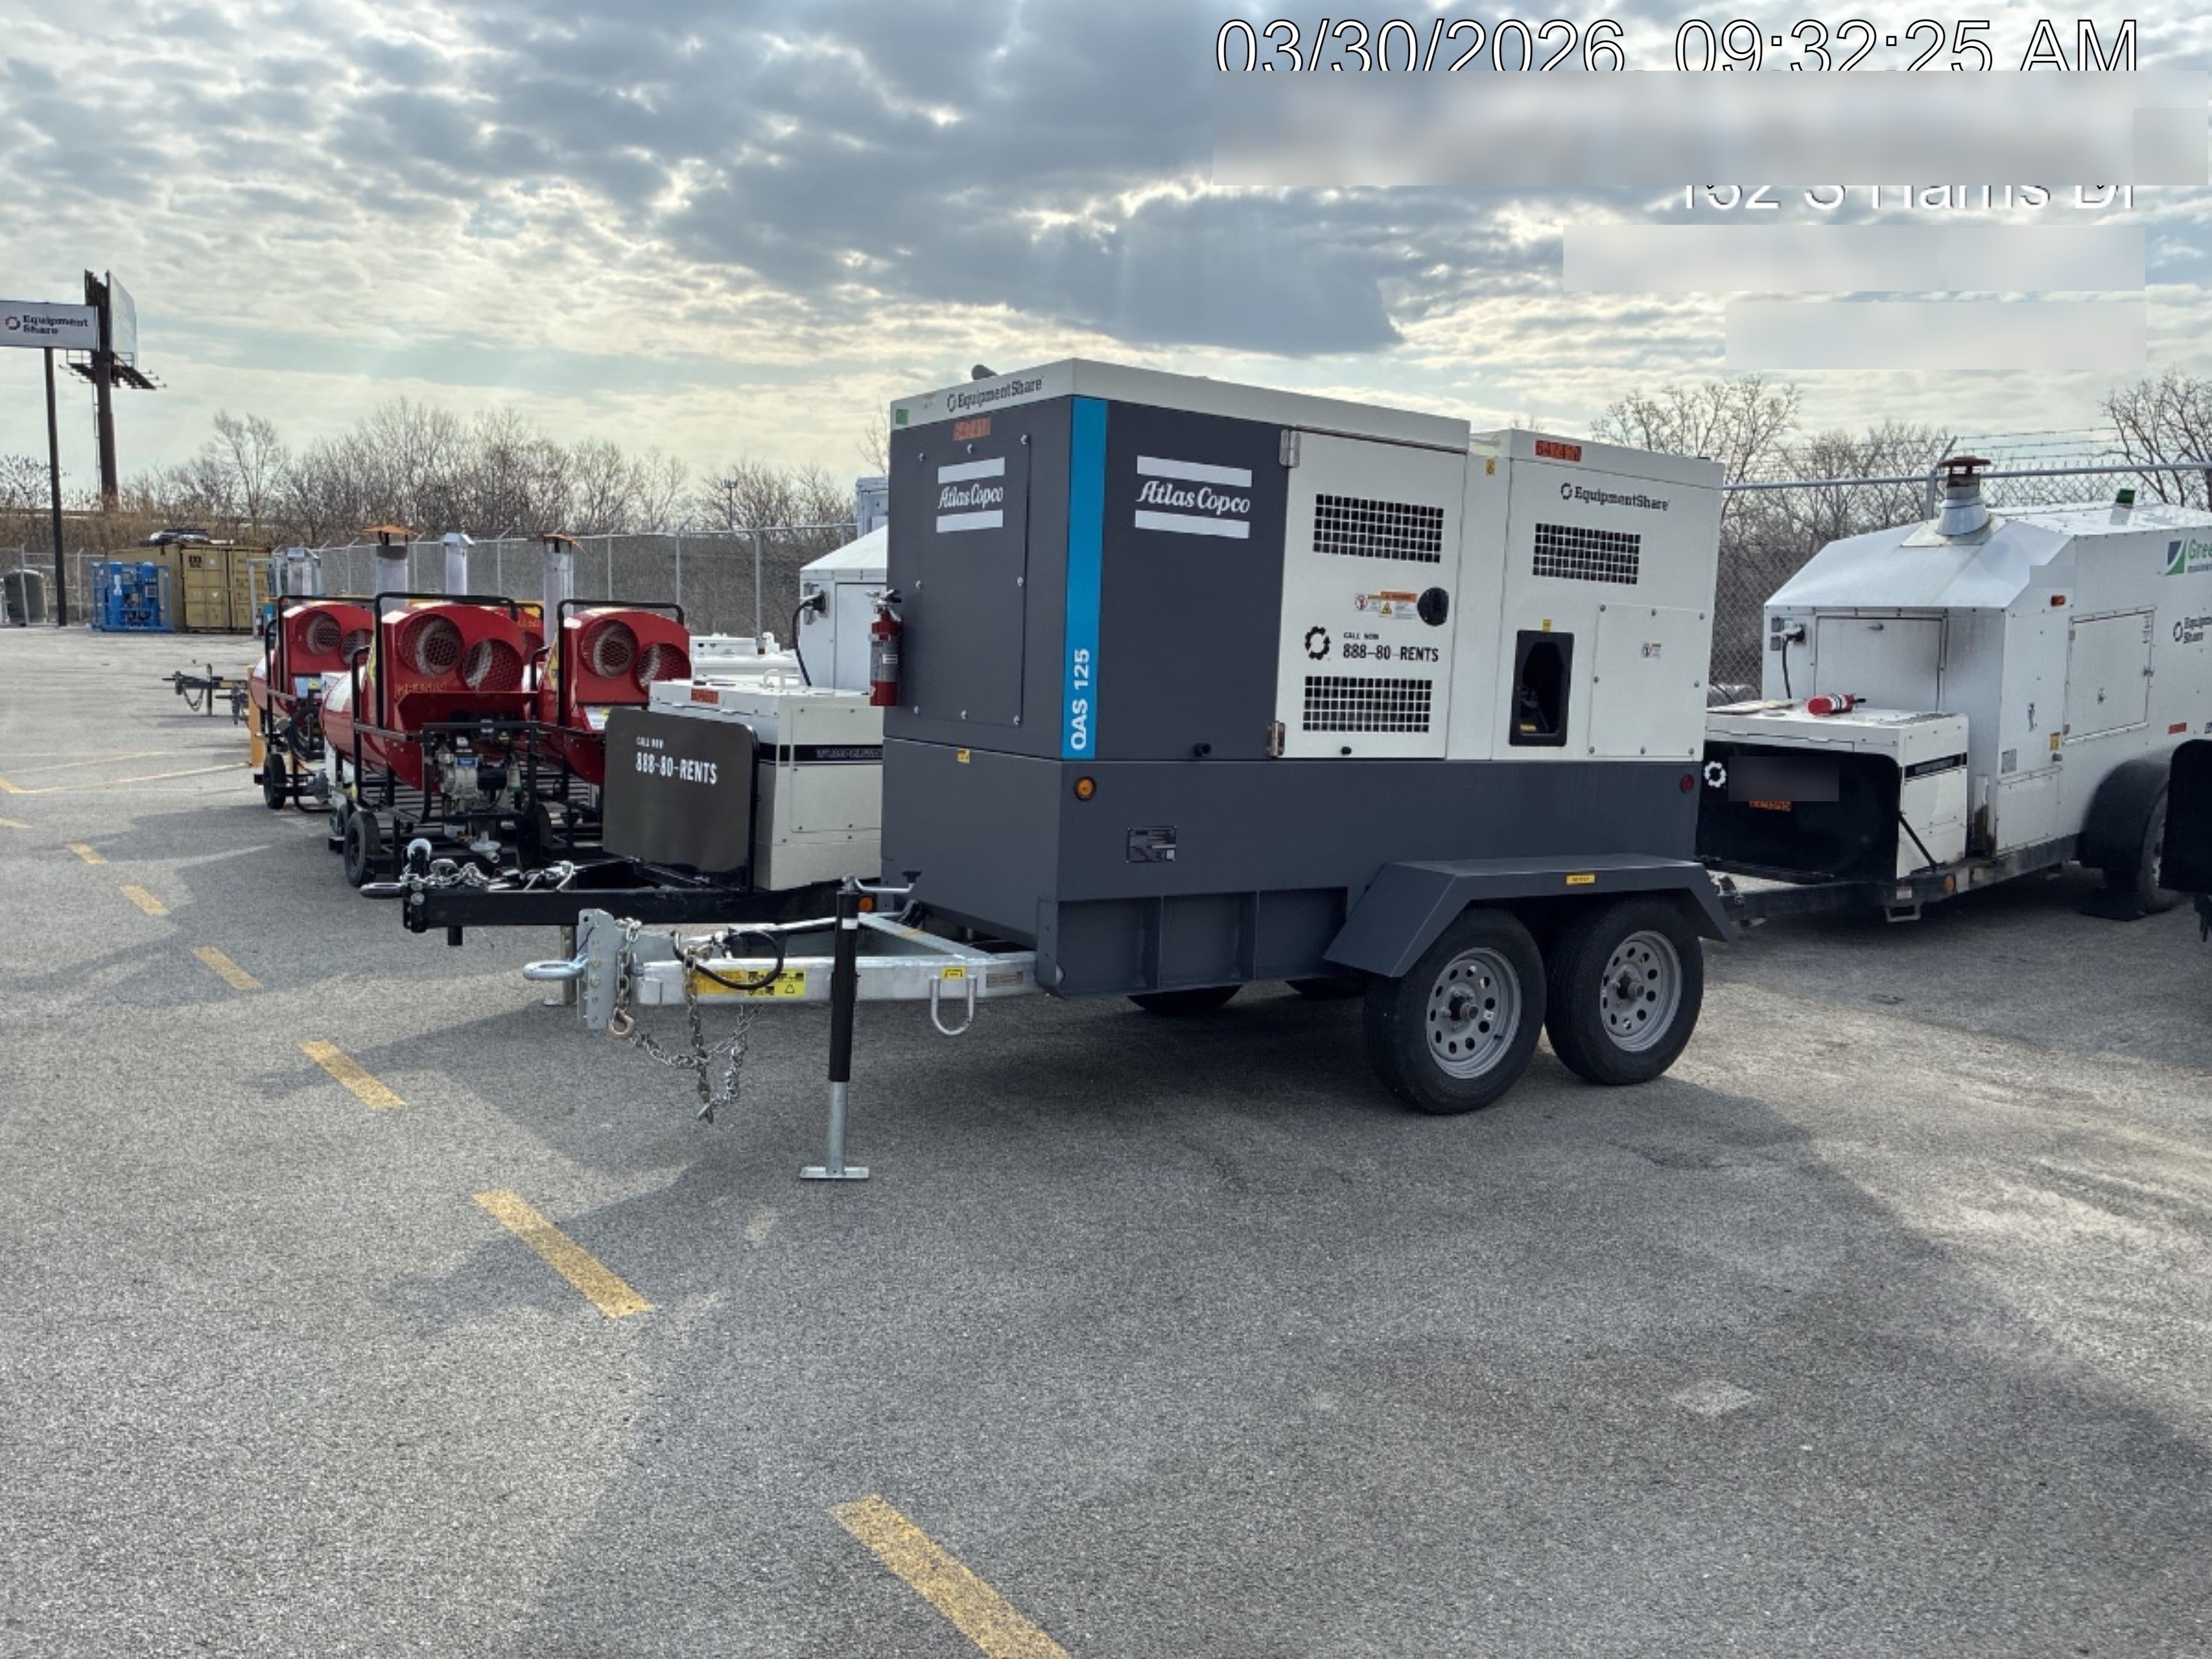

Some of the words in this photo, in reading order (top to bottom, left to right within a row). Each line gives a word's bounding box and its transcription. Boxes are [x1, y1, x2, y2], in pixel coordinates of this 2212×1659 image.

[23, 314, 89, 327] Equipment
[957, 377, 1042, 409] EquipmentShare
[937, 485, 970, 509] Atlas
[971, 482, 1003, 509] Copco
[1136, 480, 1196, 508] Atlas
[1198, 486, 1251, 516] Copco
[1574, 486, 1669, 511] EquipmentShare
[1343, 632, 1361, 640] CALL
[1343, 643, 1439, 662] 888-80-RENTS
[1073, 648, 1090, 690] 125
[1070, 697, 1088, 751] QAS
[635, 751, 718, 785] 888-80-RENTS
